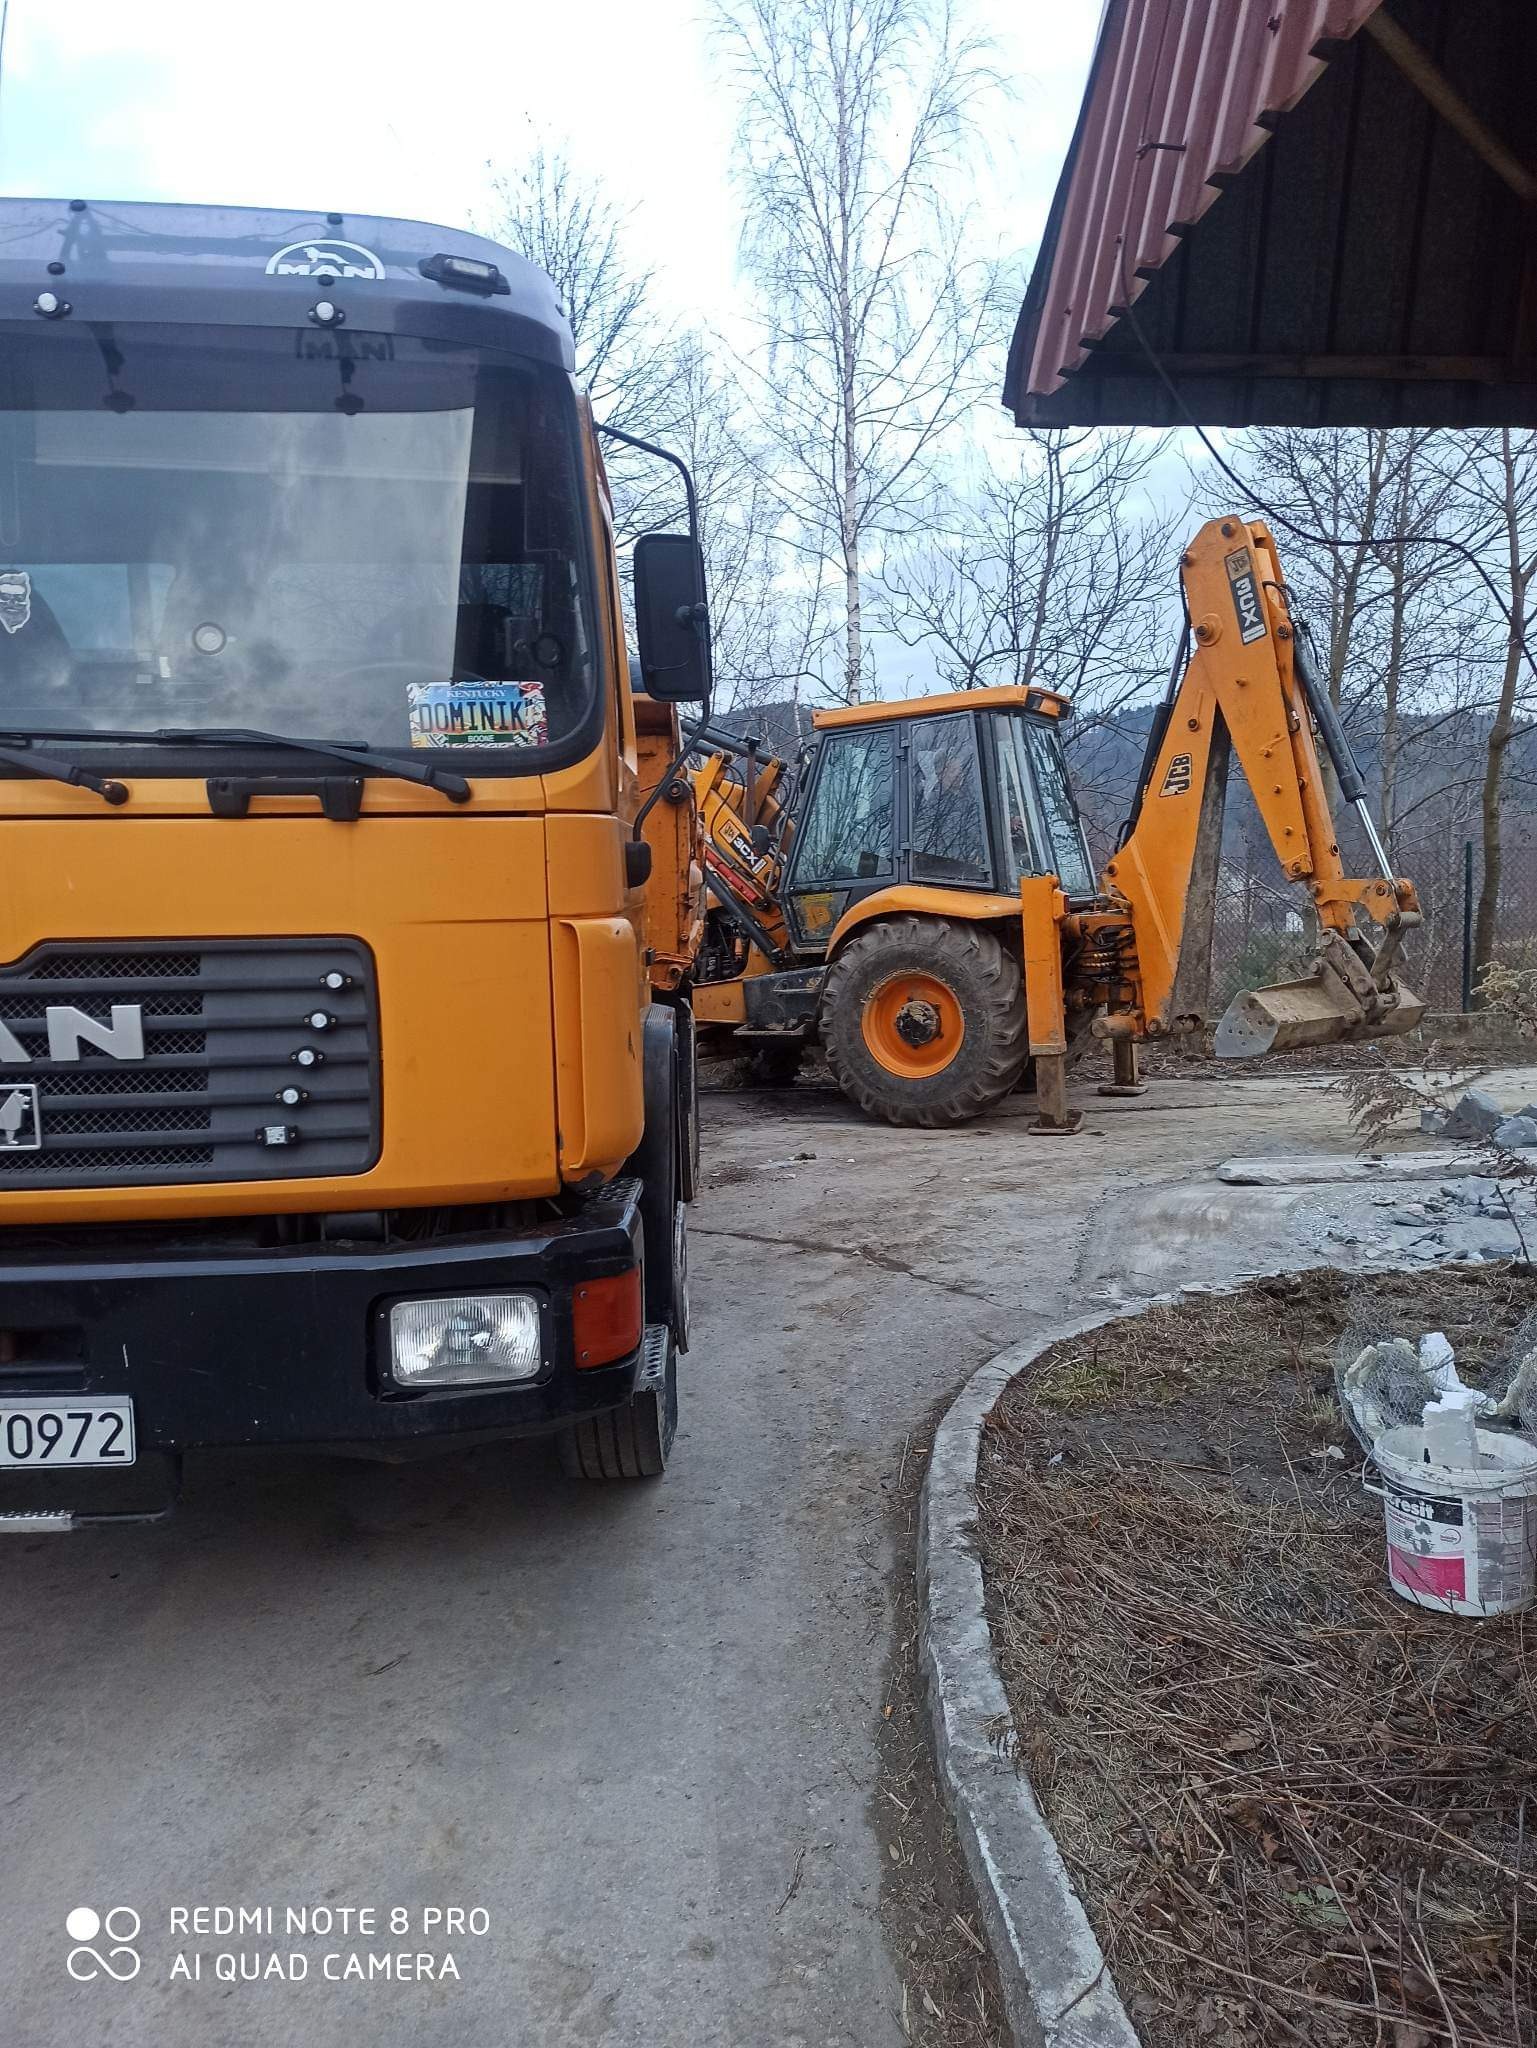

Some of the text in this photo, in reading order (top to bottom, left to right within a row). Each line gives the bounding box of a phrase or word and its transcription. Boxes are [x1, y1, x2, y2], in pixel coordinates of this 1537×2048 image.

[277, 264, 375, 279] MAN
[1235, 577, 1260, 628] 3CX
[446, 689, 507, 698] KENTUCKY
[418, 700, 527, 733] DOMINIK
[1164, 755, 1190, 791] JCB
[733, 836, 760, 866] 3CX
[0, 1412, 125, 1459] 0972
[1386, 1494, 1434, 1520] resit
